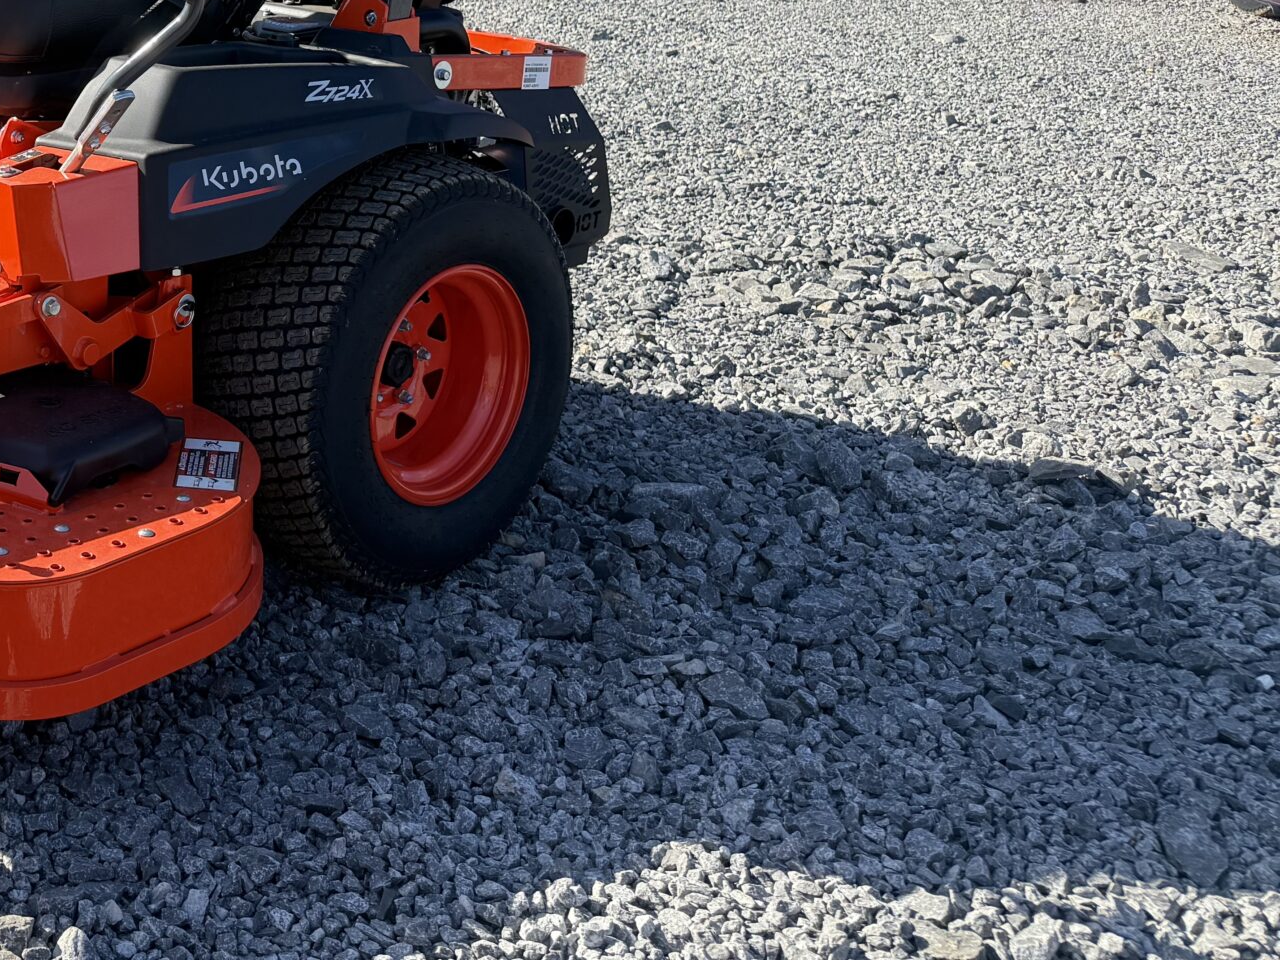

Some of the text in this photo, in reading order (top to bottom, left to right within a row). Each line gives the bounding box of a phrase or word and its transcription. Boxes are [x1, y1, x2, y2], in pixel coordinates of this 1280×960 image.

[304, 78, 375, 103] Z724X
[548, 112, 579, 135] HOT
[202, 154, 303, 190] Kubota
